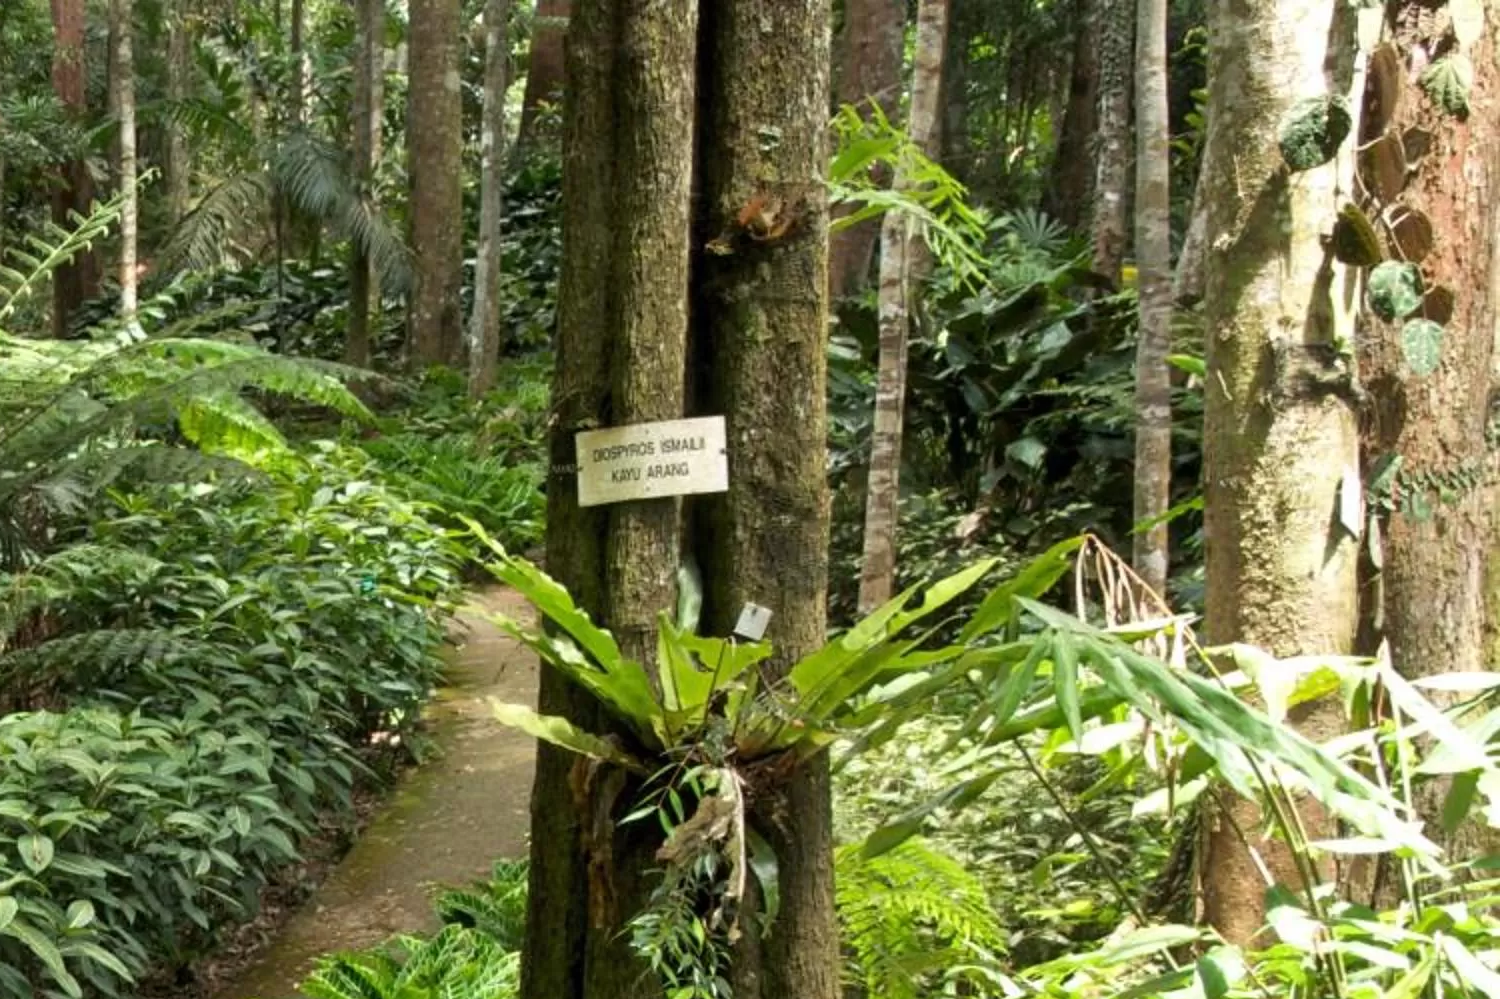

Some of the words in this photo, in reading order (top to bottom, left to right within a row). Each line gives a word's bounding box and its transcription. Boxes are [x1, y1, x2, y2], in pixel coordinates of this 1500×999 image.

[593, 441, 655, 462] DIOSPYROS
[611, 467, 641, 483] KAYU
[647, 461, 690, 479] ARANG
